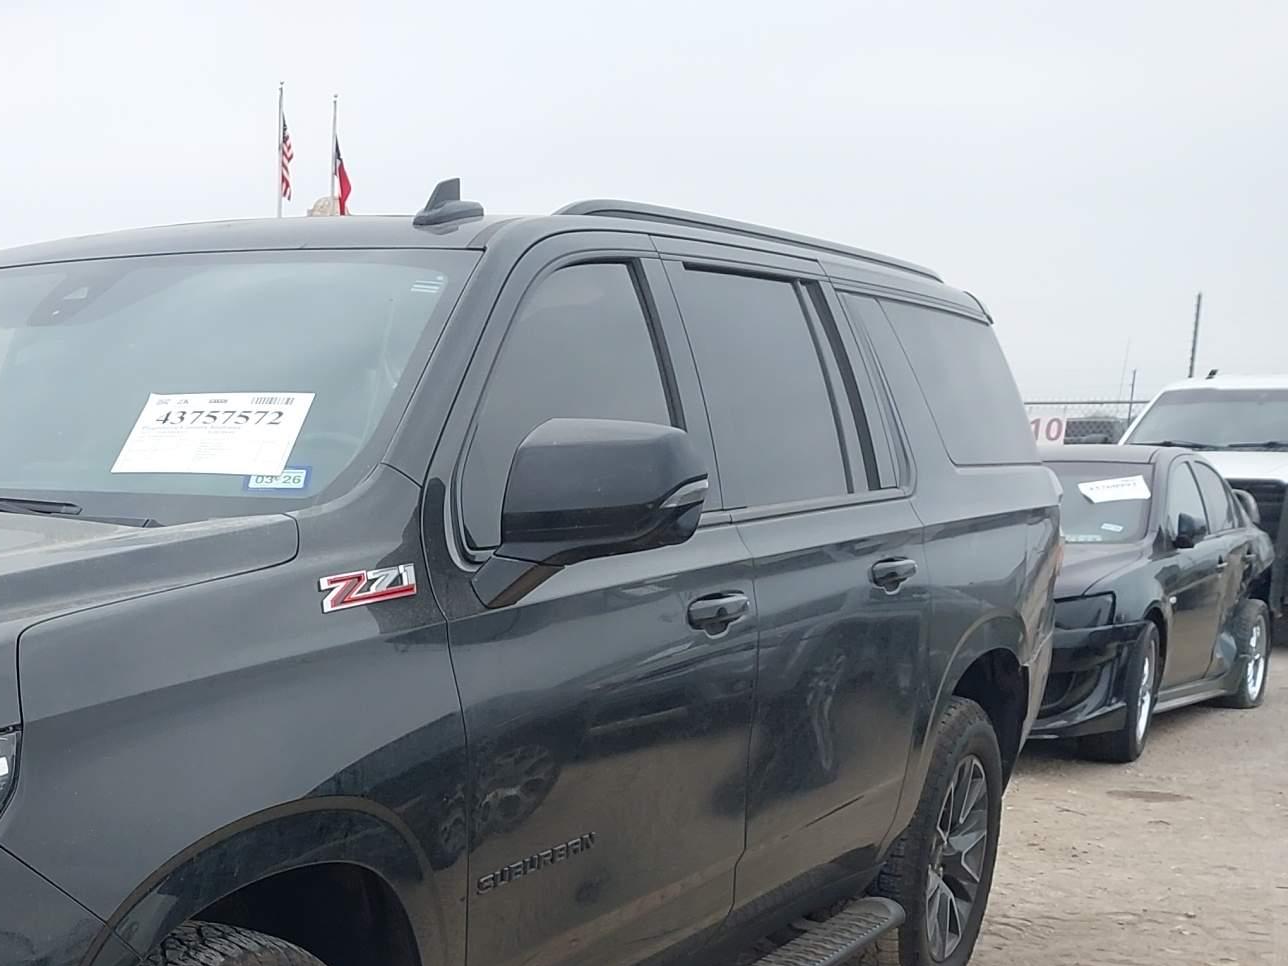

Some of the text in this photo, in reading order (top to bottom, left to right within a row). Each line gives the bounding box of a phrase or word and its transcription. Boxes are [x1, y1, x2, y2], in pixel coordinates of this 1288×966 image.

[156, 410, 284, 425] 43757572
[282, 474, 302, 484] 26
[319, 563, 417, 614] Z71
[476, 831, 597, 896] SUBURBAN
